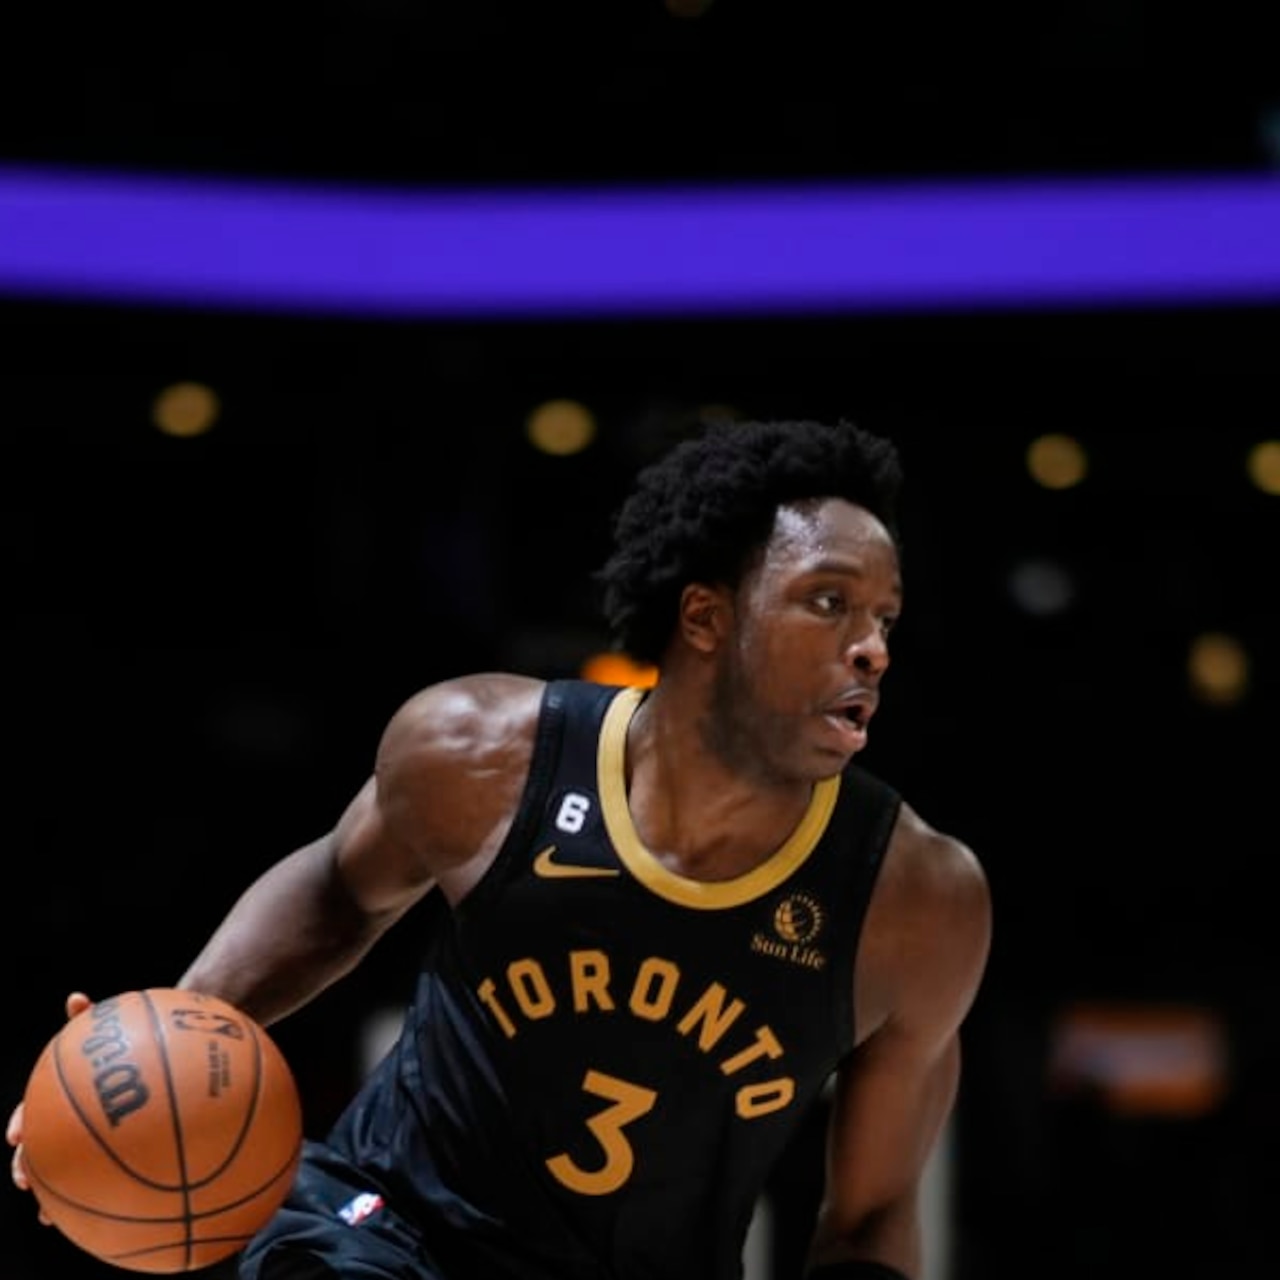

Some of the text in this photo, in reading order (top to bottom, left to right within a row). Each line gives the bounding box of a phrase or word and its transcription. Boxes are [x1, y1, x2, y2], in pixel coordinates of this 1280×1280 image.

[555, 791, 591, 834] 6
[750, 932, 826, 970] Sun Life
[476, 947, 797, 1121] TORONTO
[545, 1067, 660, 1197] 3
